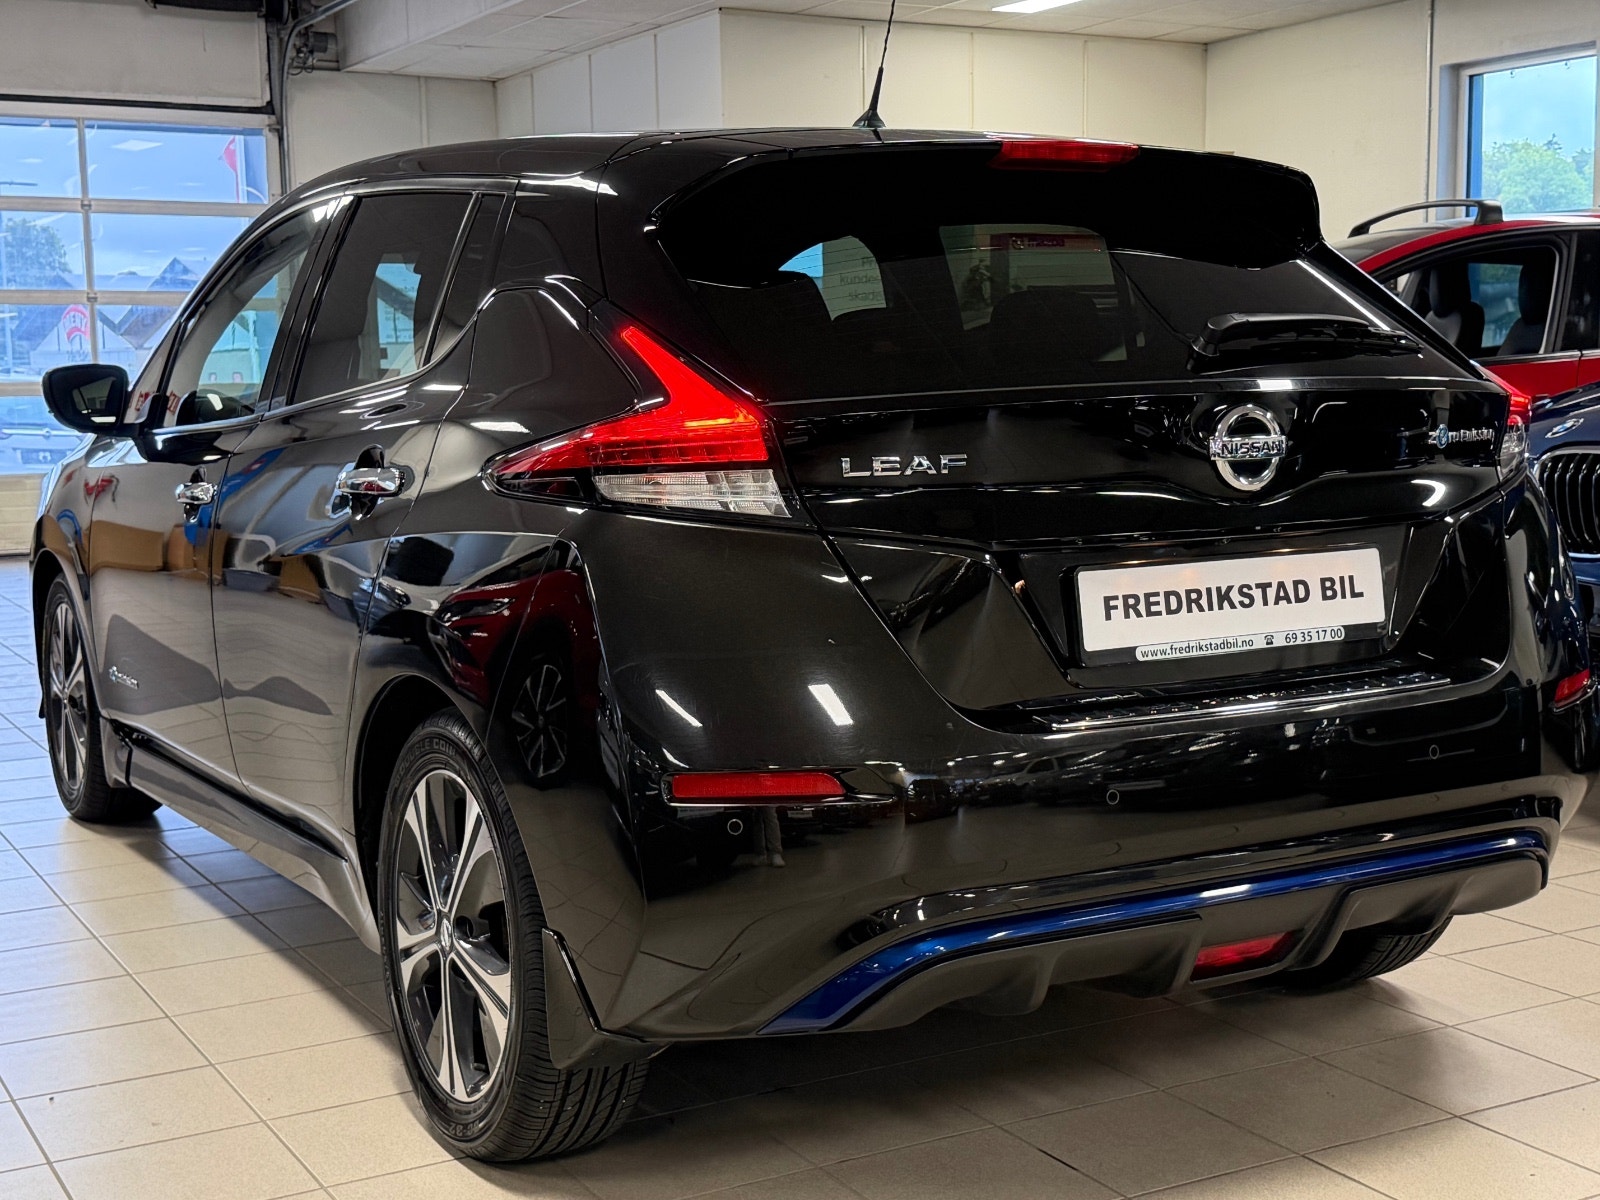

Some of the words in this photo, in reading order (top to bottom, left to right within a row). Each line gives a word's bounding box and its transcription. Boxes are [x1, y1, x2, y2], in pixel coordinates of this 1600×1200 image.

[1221, 440, 1284, 455] NISSAN
[840, 453, 968, 478] LEAF
[1103, 579, 1311, 621] FREDRIKSTAD
[1319, 574, 1364, 602] BIL
[1140, 637, 1254, 659] www.fredrikstadbil.no
[1284, 631, 1299, 644] 69
[1300, 630, 1314, 643] 35
[1315, 629, 1329, 641] 17
[1330, 627, 1343, 640] 00
